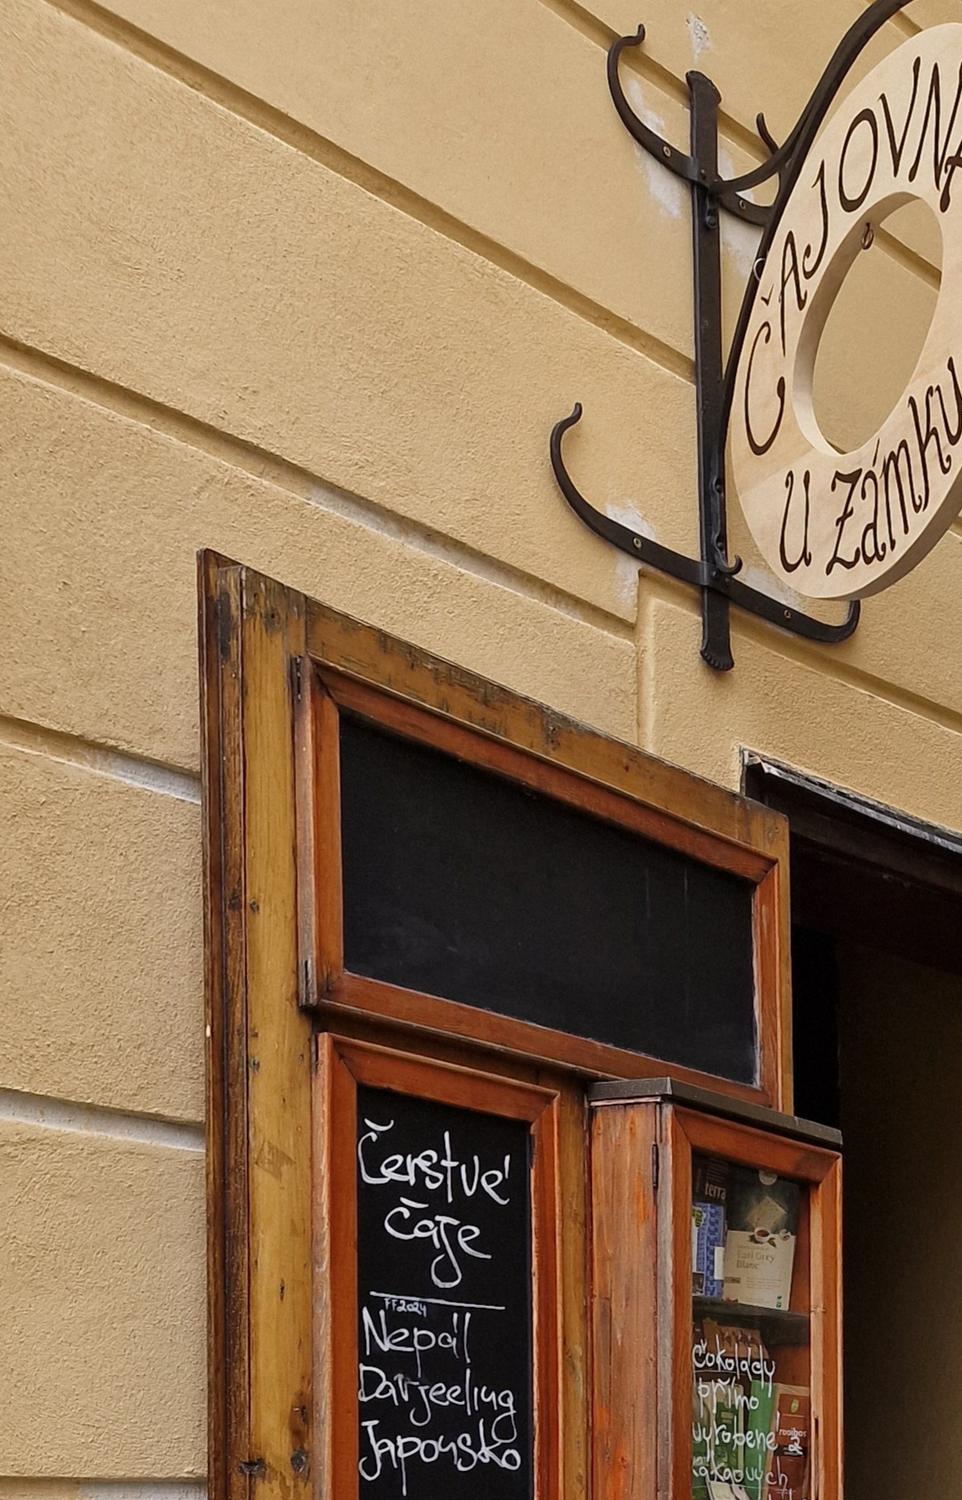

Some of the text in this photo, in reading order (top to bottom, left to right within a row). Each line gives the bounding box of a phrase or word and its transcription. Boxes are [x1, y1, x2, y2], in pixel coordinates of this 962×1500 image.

[780, 470, 811, 573] U
[358, 1118, 510, 1205] Čerstvé
[362, 1306, 472, 1378] Nepál
[358, 1363, 517, 1443] Darjeeling
[699, 1376, 760, 1418] přímo
[359, 1419, 521, 1496] Japonsko
